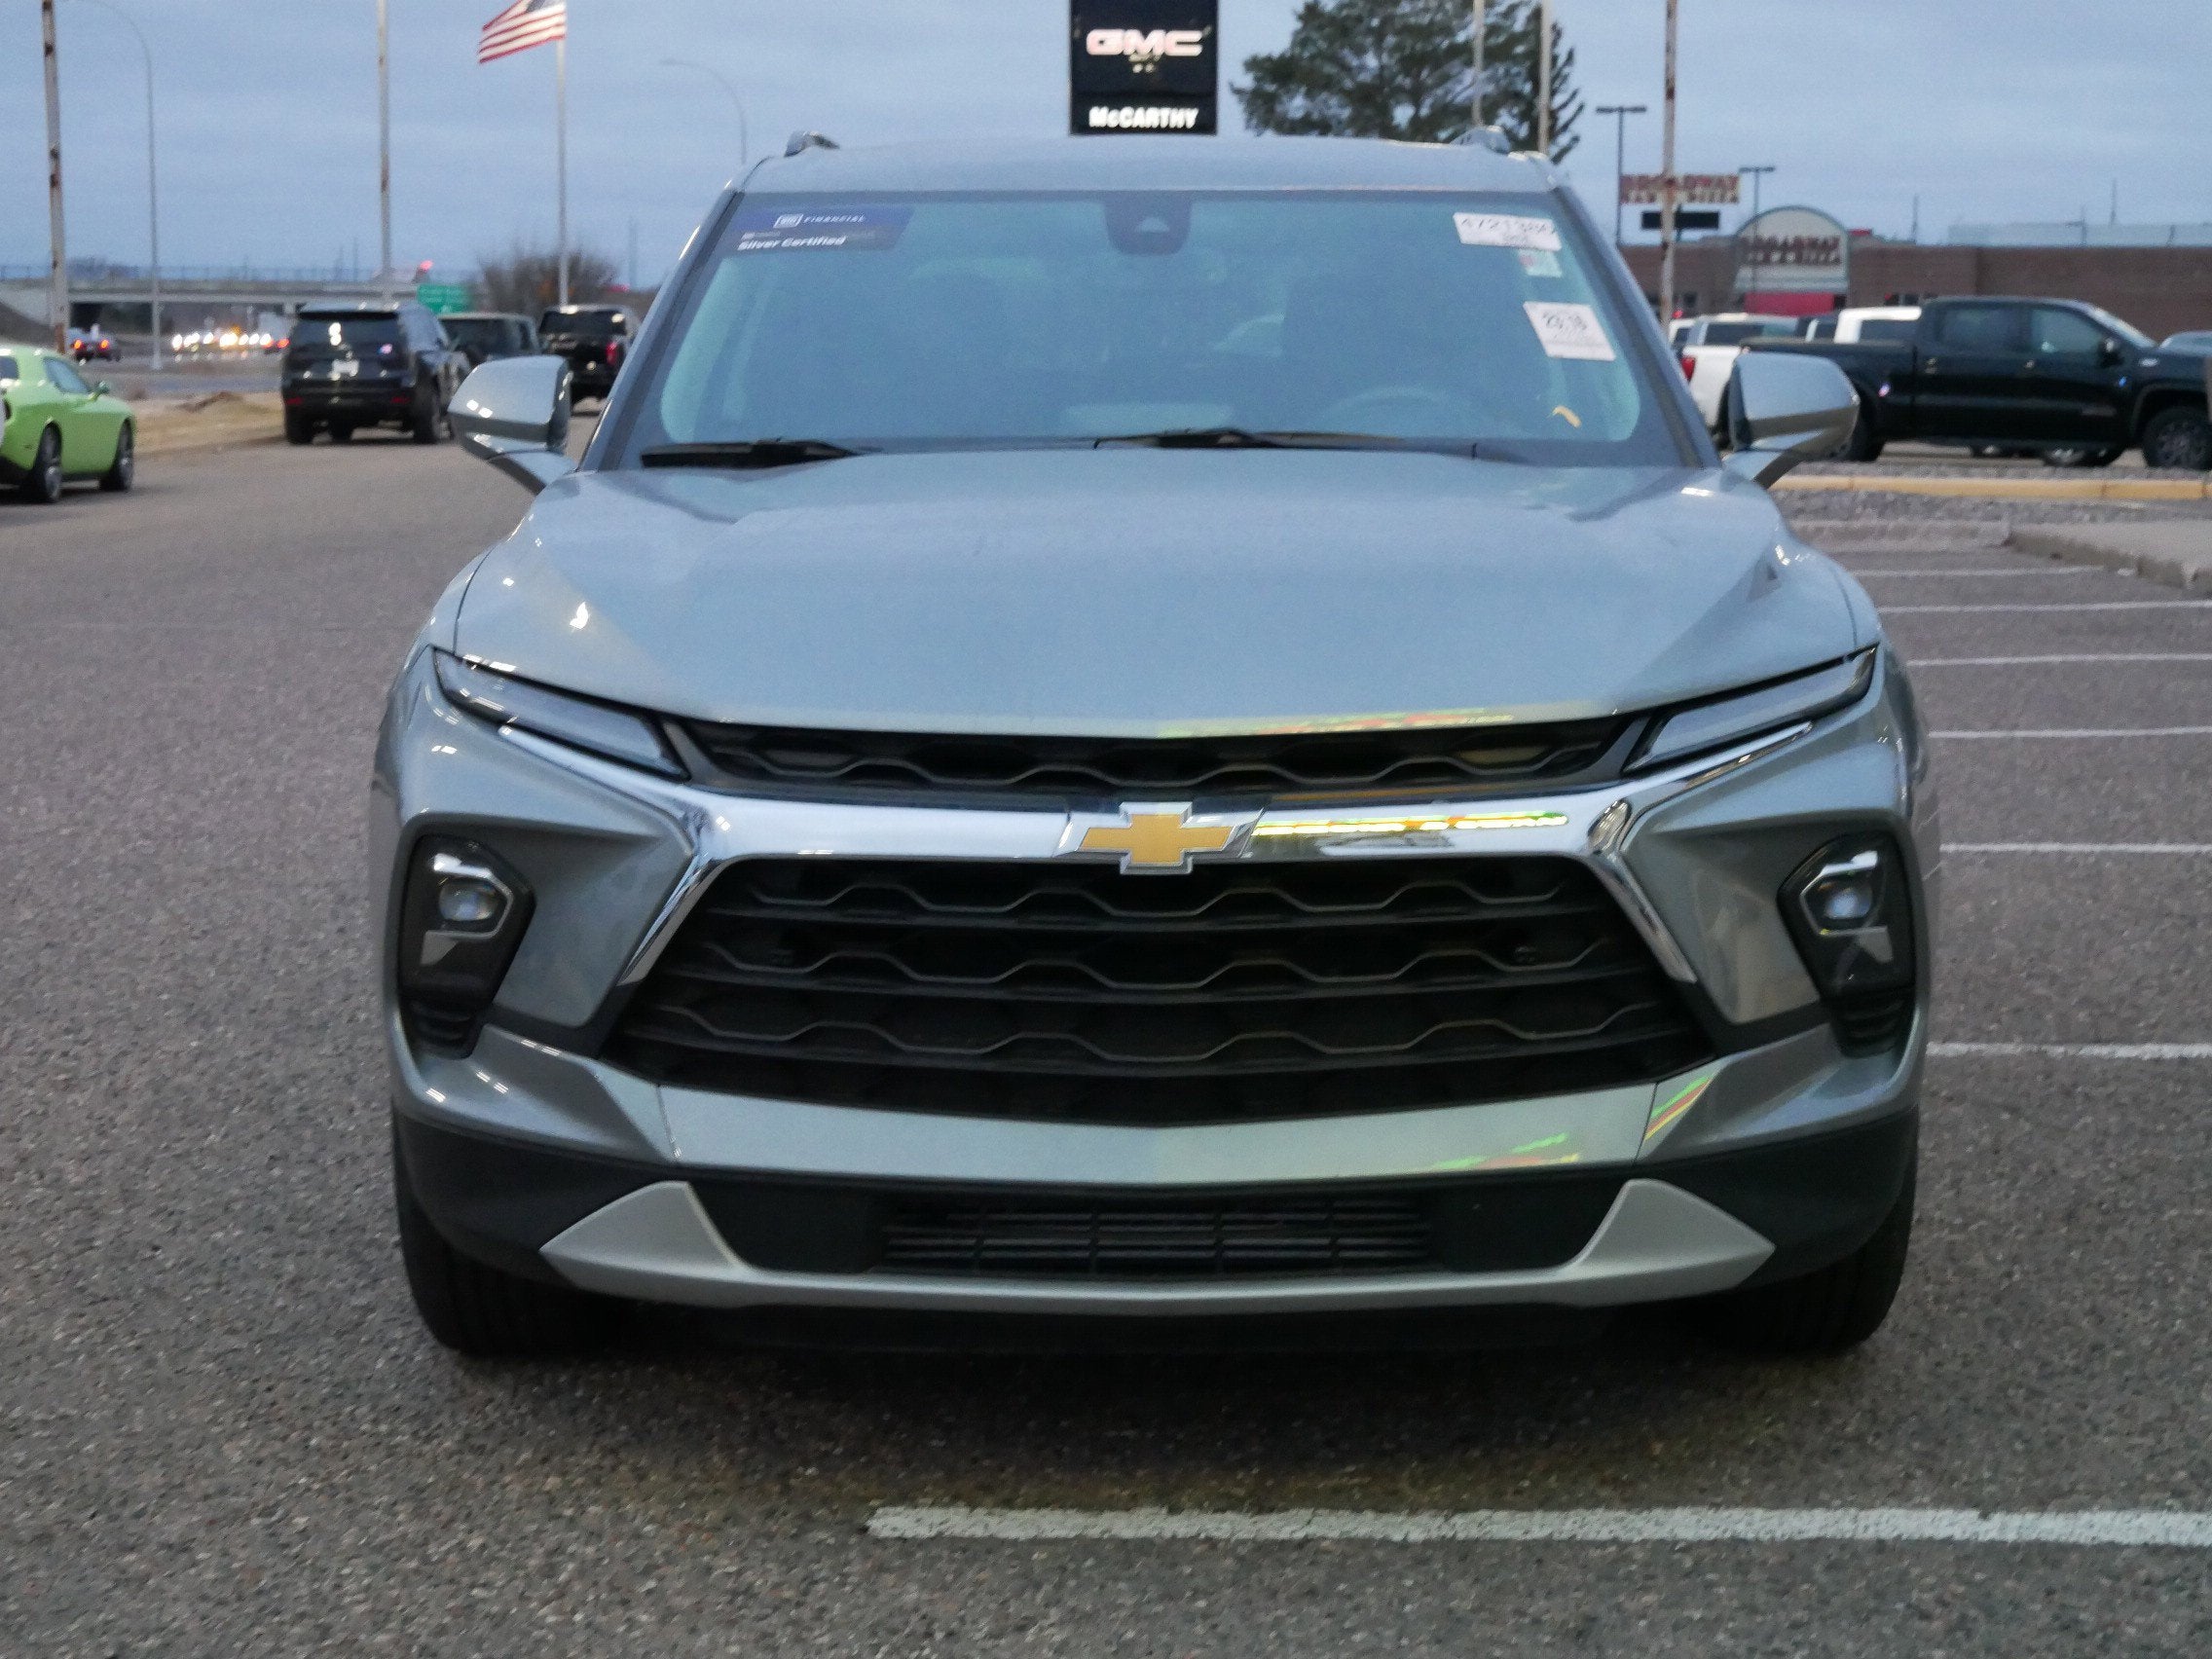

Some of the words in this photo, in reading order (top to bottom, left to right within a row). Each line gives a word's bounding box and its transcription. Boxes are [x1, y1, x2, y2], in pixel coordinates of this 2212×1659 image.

[1087, 29, 1203, 56] GMC
[1088, 106, 1198, 129] McCARTHY
[737, 240, 780, 251] Silver
[781, 236, 847, 248] Certified
